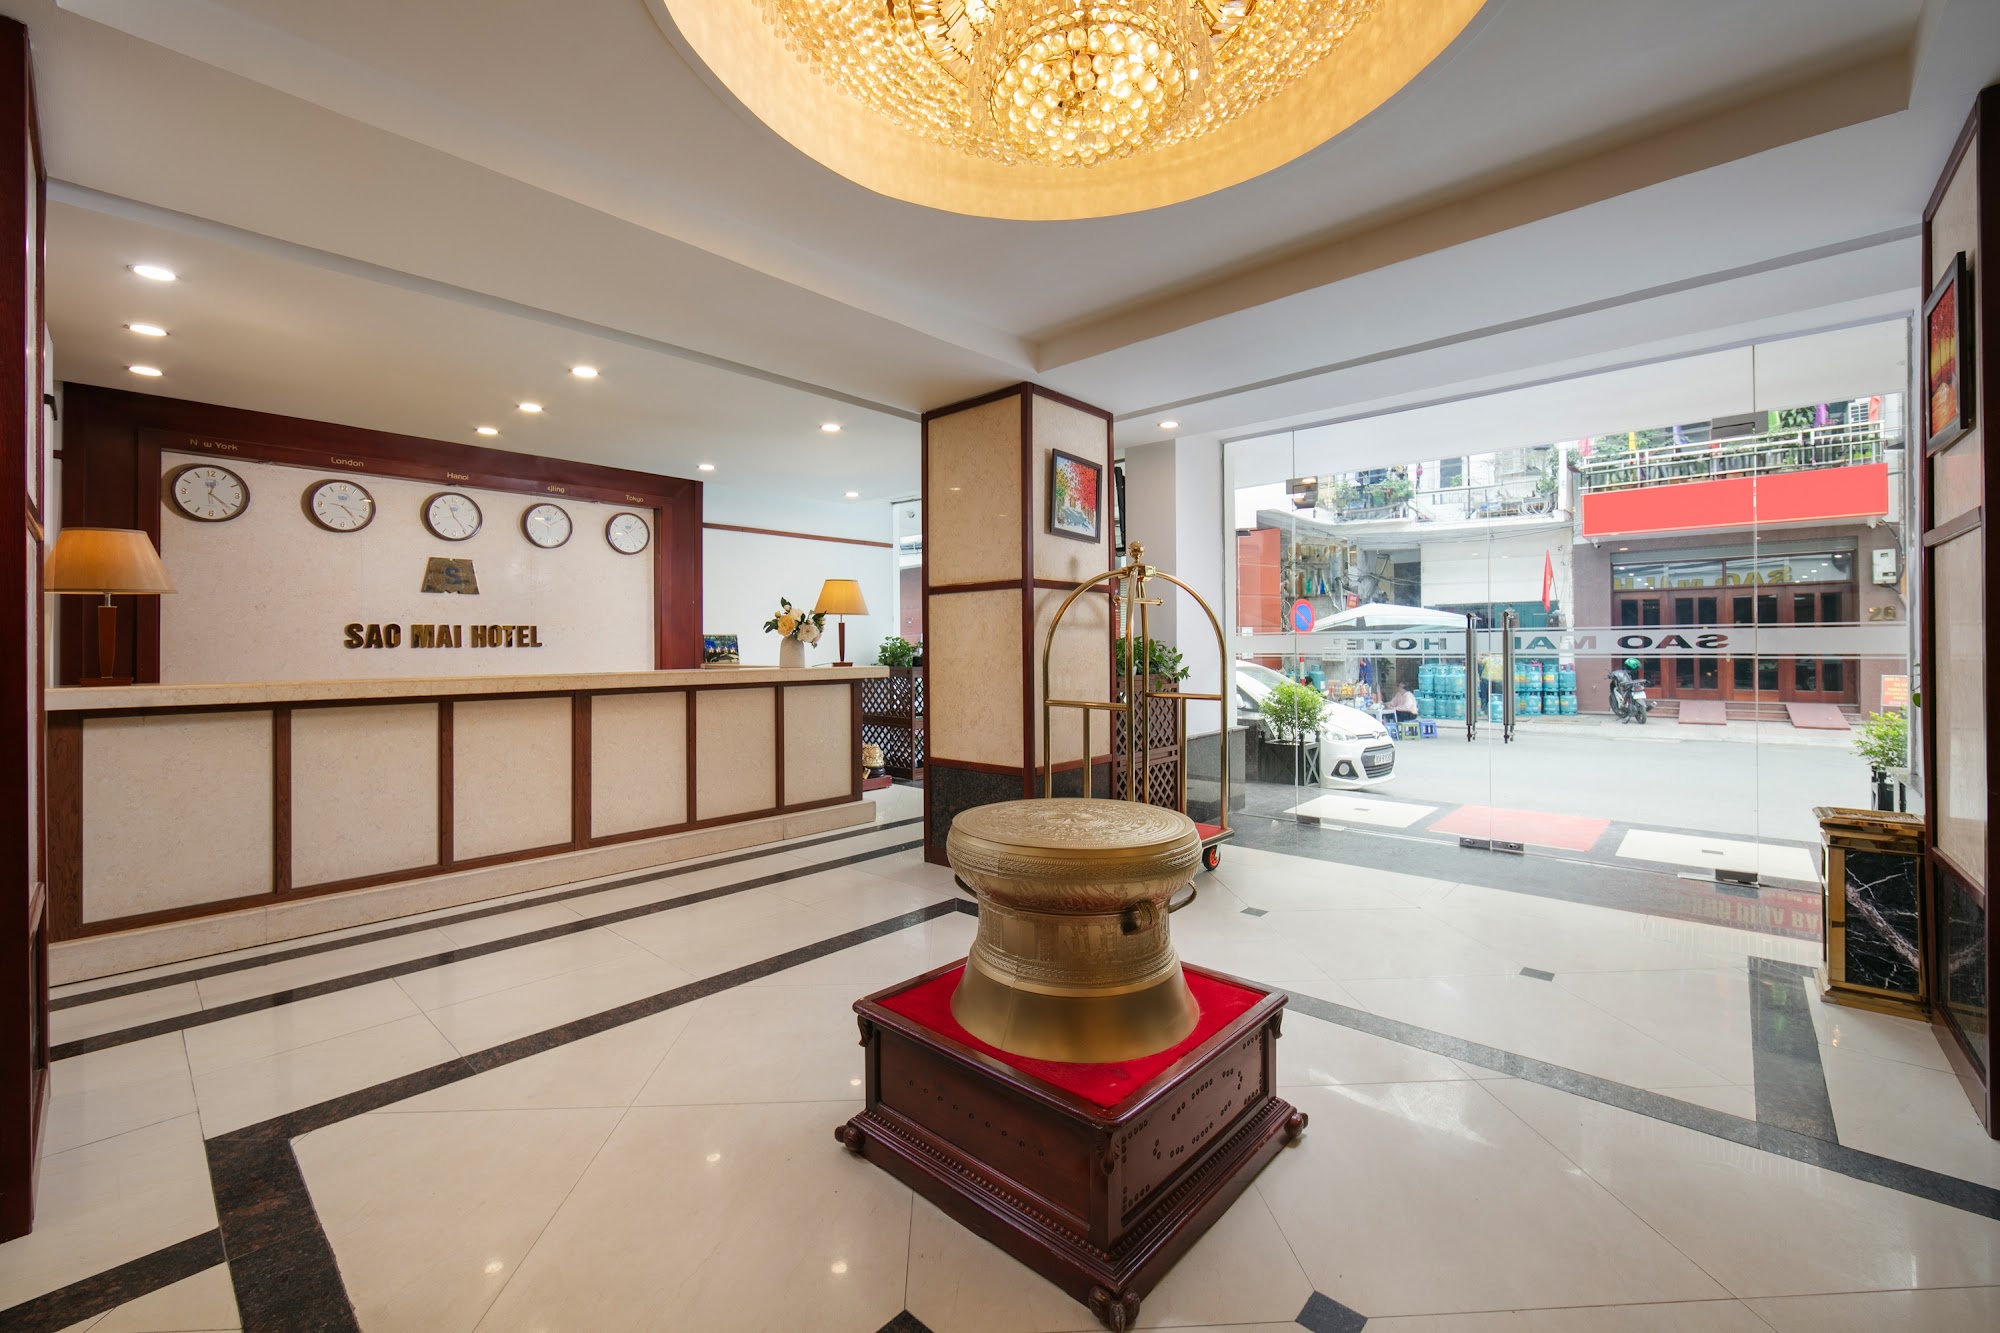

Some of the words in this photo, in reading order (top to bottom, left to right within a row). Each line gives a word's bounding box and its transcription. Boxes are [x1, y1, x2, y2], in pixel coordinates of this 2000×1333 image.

[190, 439, 212, 448] Nw
[215, 442, 238, 451] York
[330, 456, 364, 467] London
[206, 470, 216, 478] 12
[446, 471, 469, 481] Hanoi
[625, 494, 644, 503] Tokyo
[1869, 606, 1896, 621] 26
[344, 623, 401, 649] SAO
[410, 624, 462, 648] MAI
[470, 624, 543, 648] HOTEL
